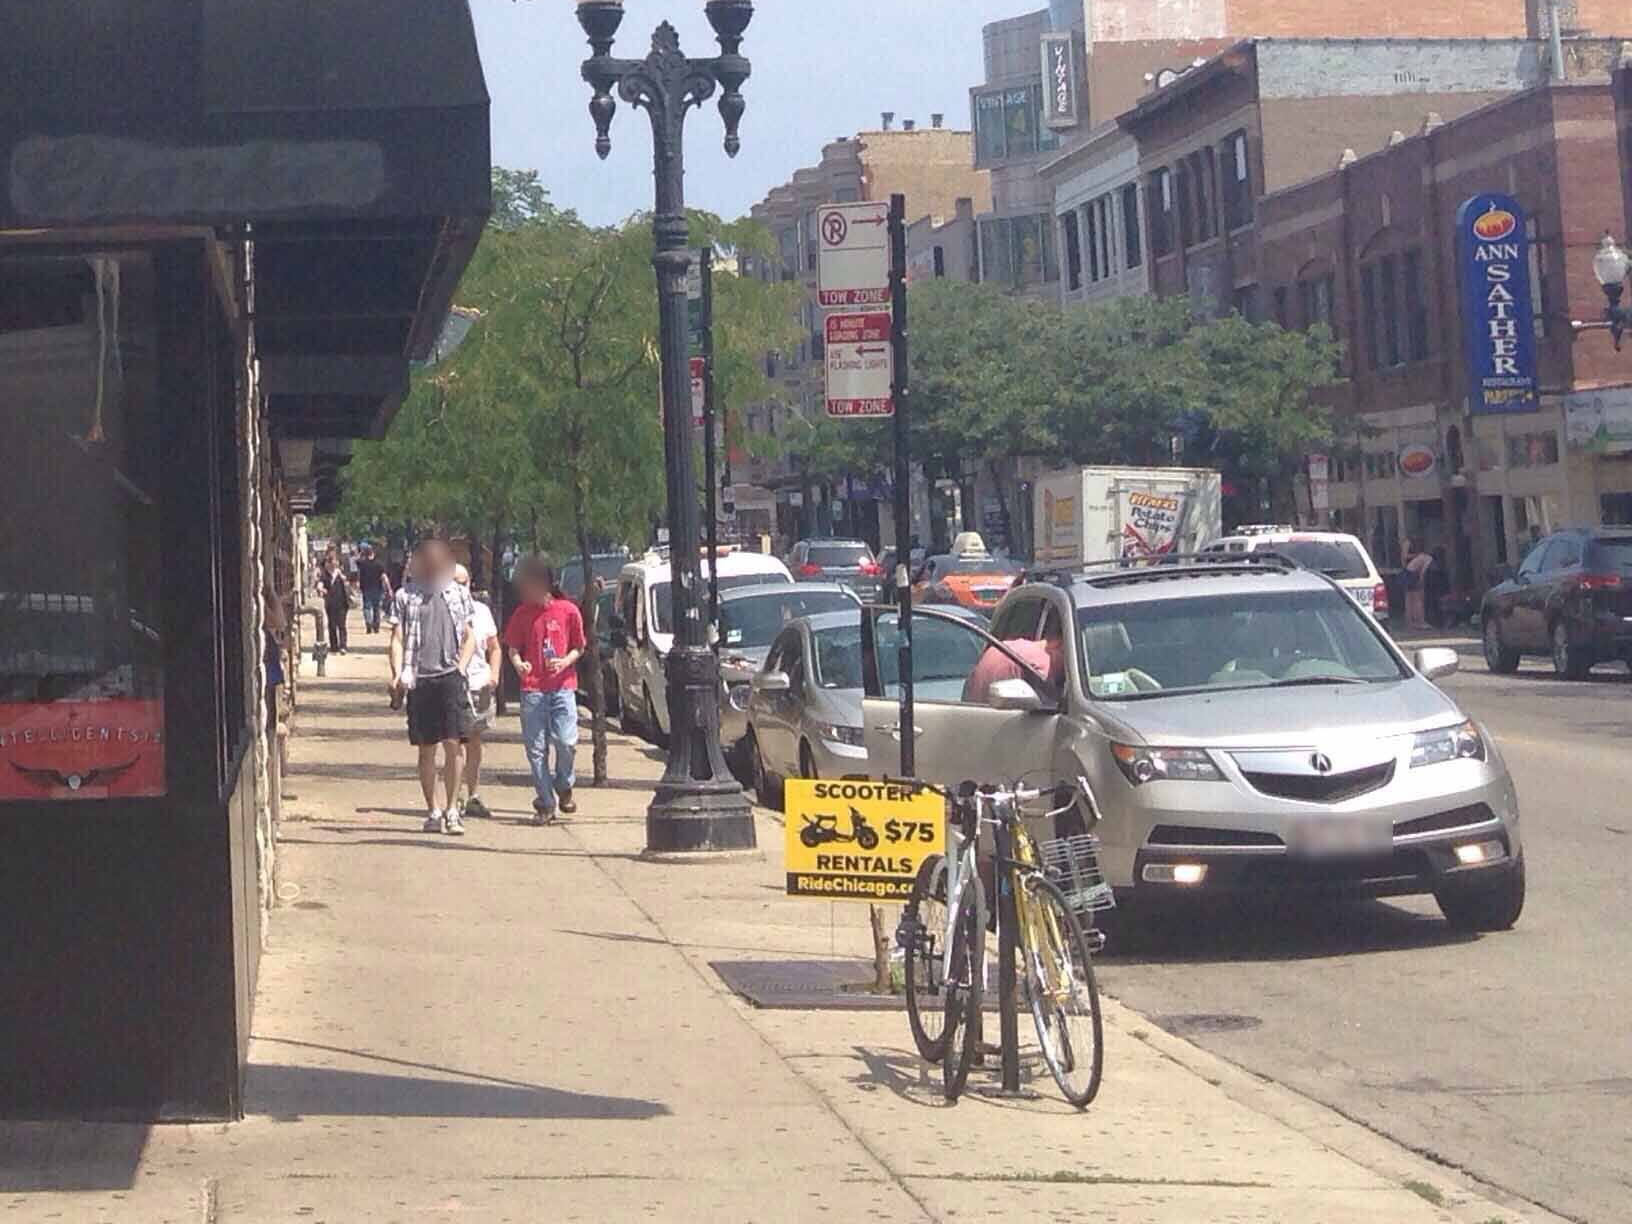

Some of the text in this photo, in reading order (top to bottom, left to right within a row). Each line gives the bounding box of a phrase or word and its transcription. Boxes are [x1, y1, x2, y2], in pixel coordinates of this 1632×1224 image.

[1475, 244, 1519, 261] ANN
[824, 288, 885, 304] TOW ZONE
[1486, 263, 1519, 375] SATHER
[830, 398, 888, 414] TOW ZONE
[814, 783, 913, 802] SCOOTER
[884, 818, 935, 843] $75
[816, 854, 913, 874] RENTALS
